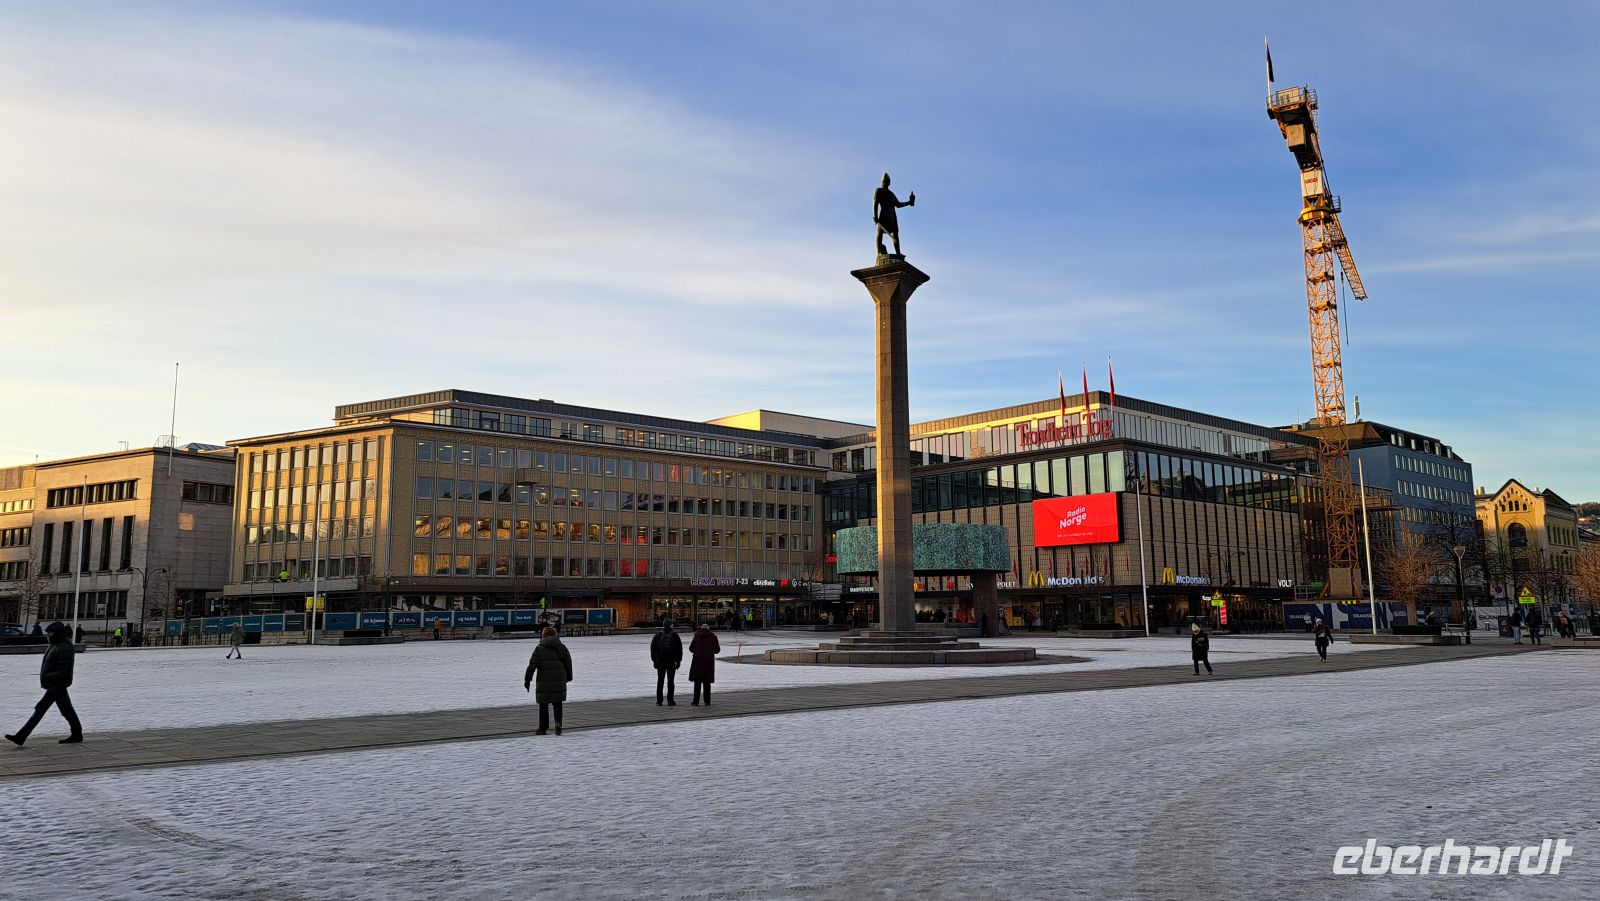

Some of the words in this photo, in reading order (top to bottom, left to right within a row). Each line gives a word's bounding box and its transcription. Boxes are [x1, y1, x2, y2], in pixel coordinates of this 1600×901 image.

[1016, 422, 1081, 446] Trondheim
[1082, 412, 1113, 441] Torg
[1066, 505, 1086, 518] Radio
[1059, 512, 1087, 530] Norge
[690, 577, 715, 586] REMA
[716, 577, 735, 586] 1000
[736, 577, 749, 586] 7-23
[1047, 576, 1105, 587] McDonald's
[1175, 575, 1211, 585] McDonald's
[1277, 579, 1292, 588] VOLT
